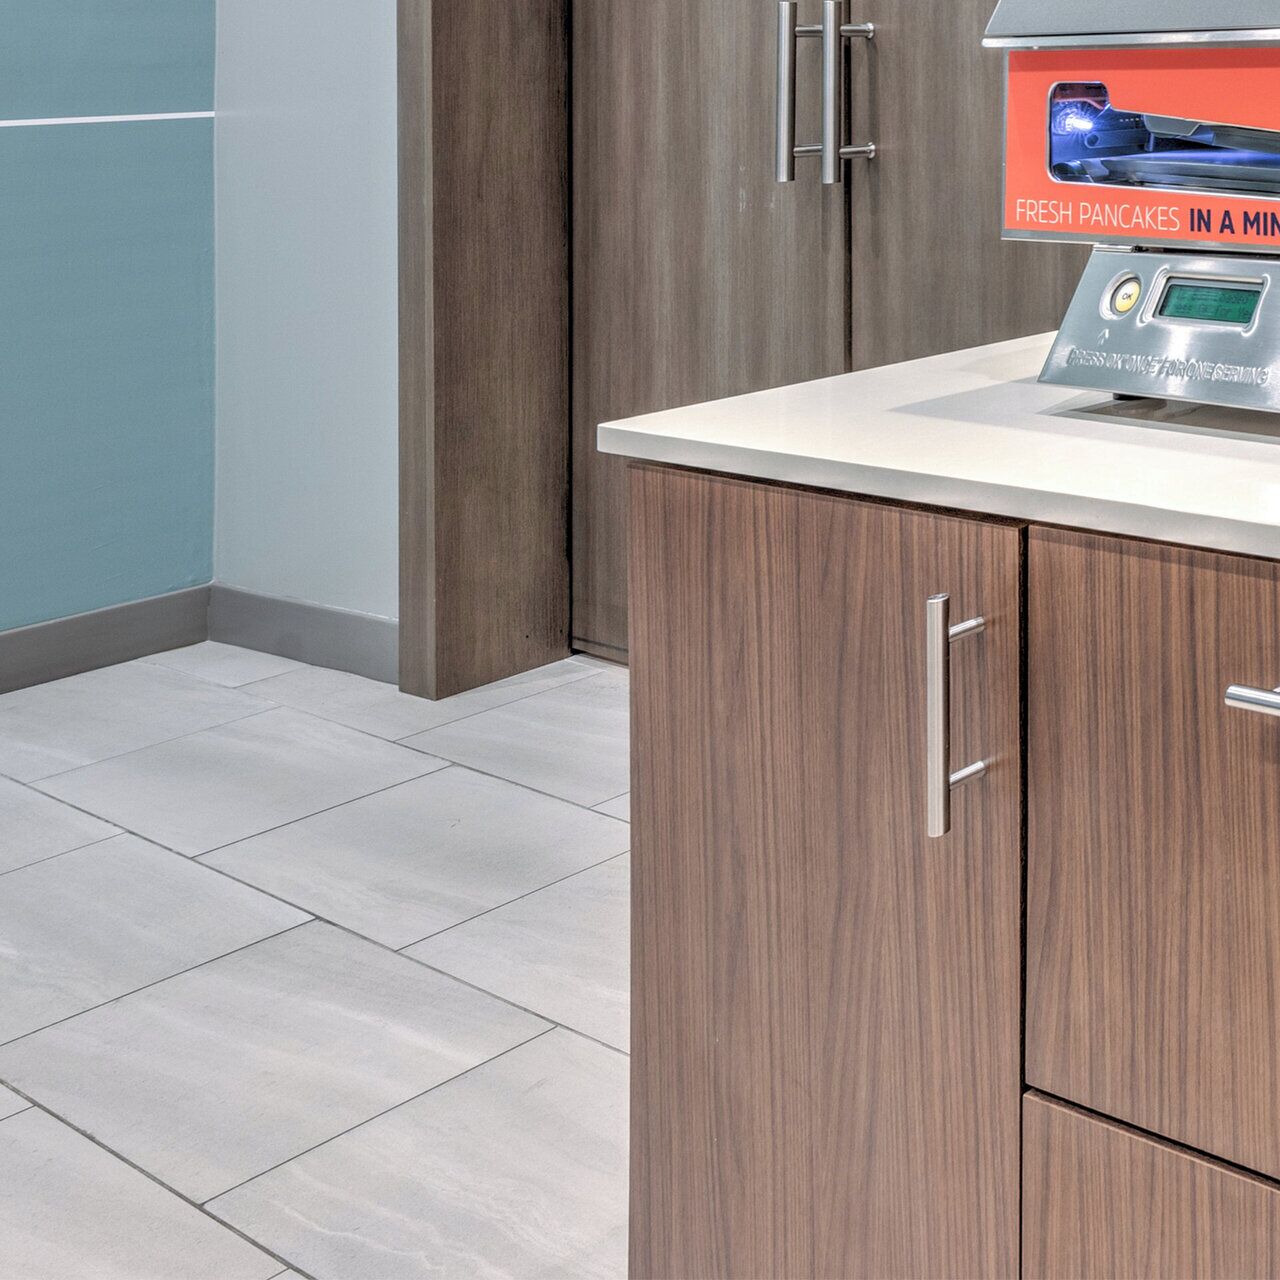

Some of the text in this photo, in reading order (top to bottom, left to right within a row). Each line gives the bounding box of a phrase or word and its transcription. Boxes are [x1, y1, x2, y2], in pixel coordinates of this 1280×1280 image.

[1016, 198, 1072, 225] FRESH
[1080, 203, 1180, 232] PANCAKES
[1189, 208, 1212, 233] IN
[1219, 210, 1236, 235] A
[1121, 293, 1134, 301] OK
